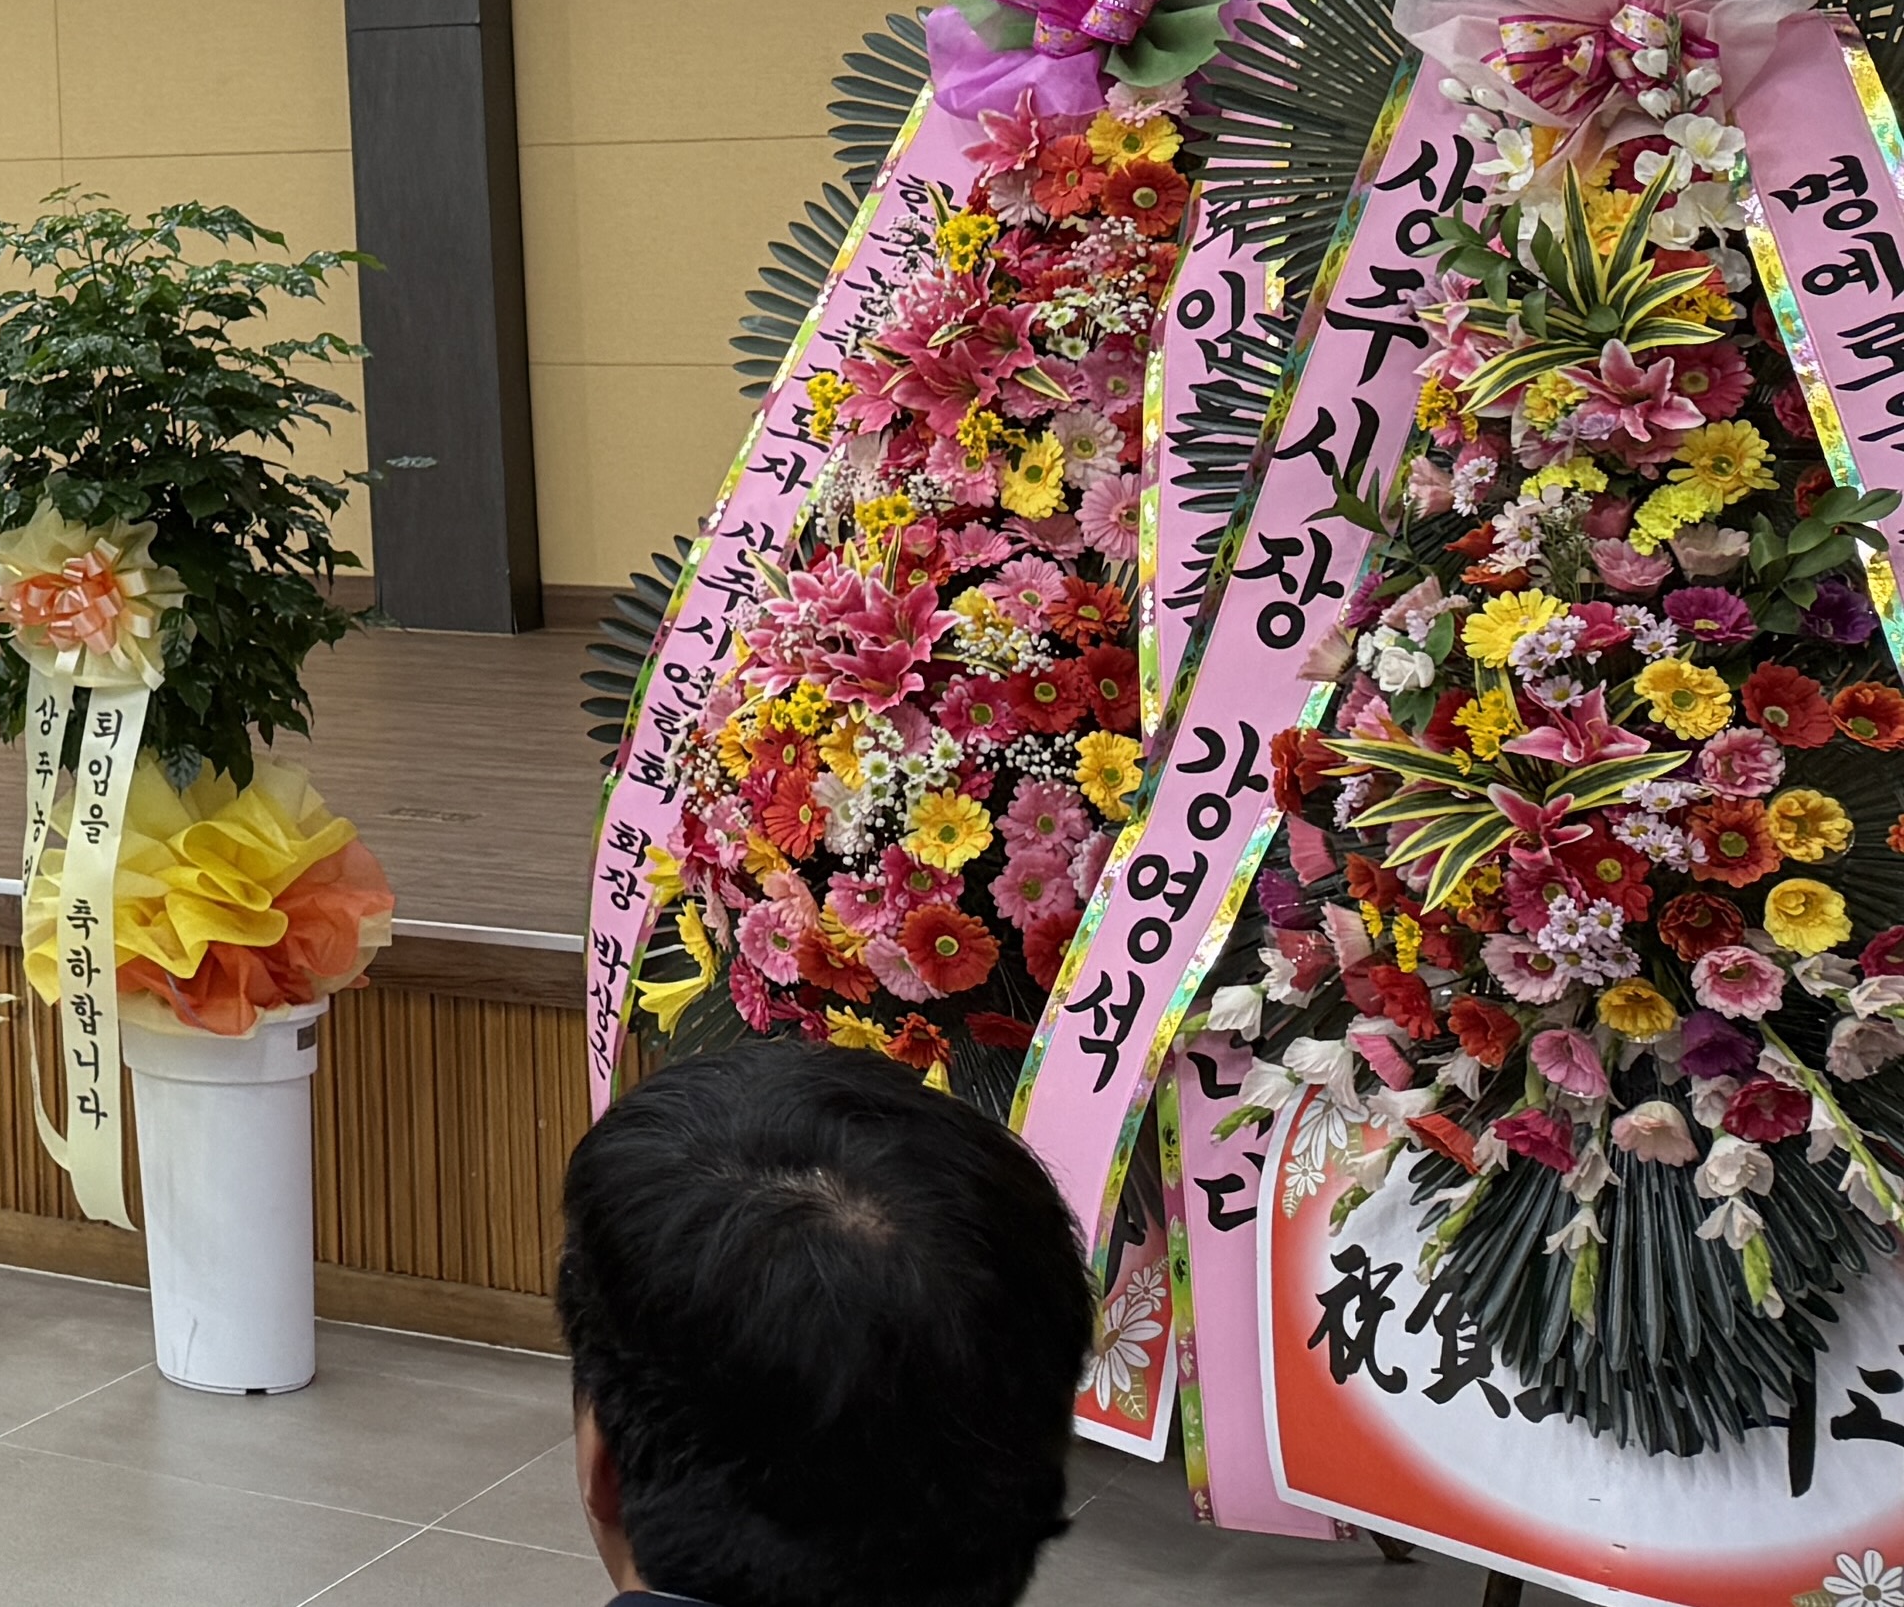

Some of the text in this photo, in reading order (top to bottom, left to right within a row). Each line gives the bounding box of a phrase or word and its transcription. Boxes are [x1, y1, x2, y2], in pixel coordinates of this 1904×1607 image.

[1064, 134, 1487, 1093] 상주시장 강영석
[66, 708, 124, 1131] 퇴임을 축하합니다
[599, 820, 653, 911] 회장
